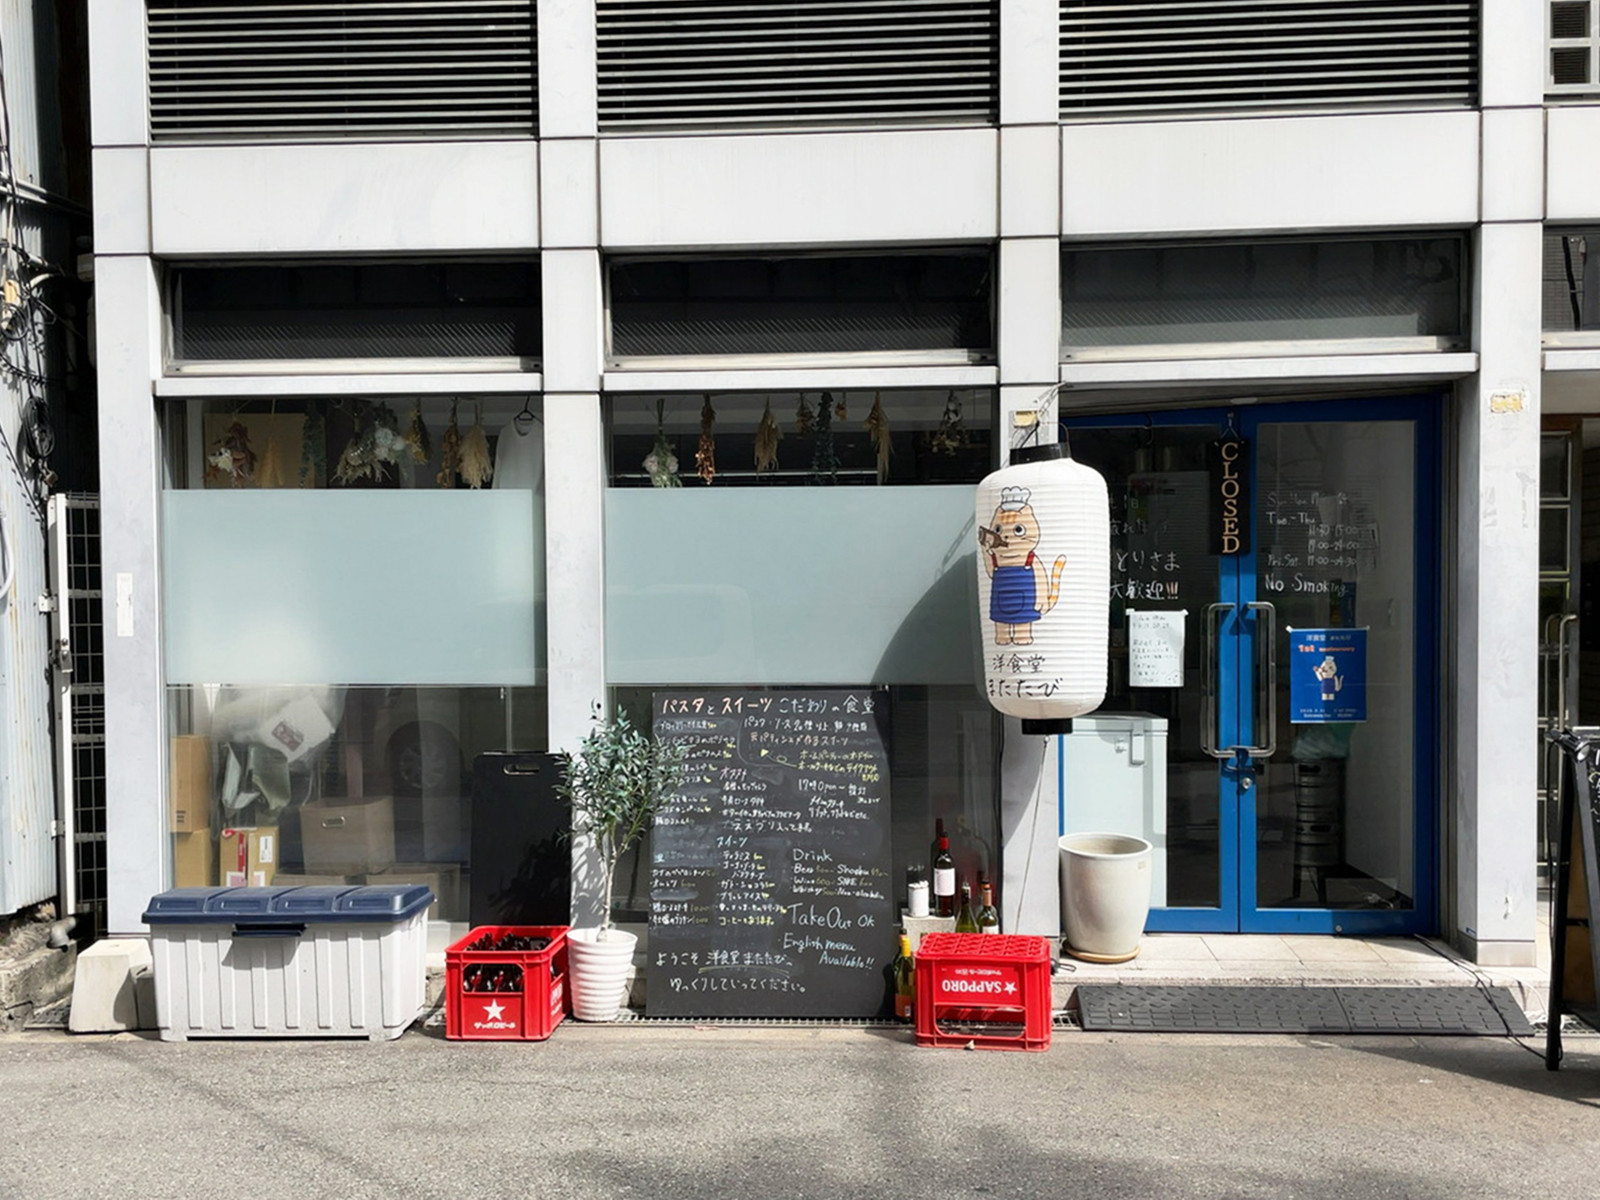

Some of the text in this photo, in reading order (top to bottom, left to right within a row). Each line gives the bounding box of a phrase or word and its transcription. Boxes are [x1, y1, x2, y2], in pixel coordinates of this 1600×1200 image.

[1221, 442, 1240, 554] CLOSED
[1265, 573, 1285, 592] No
[993, 653, 1046, 673] 洋食堂
[988, 677, 1063, 698] またたび
[721, 697, 773, 714] スイーツ
[793, 848, 833, 862] Drink
[783, 932, 857, 953] English menu
[656, 952, 699, 966] ようこそ
[670, 977, 806, 992] ゆっくりしていってください。
[942, 980, 1002, 994] SAPPORO
